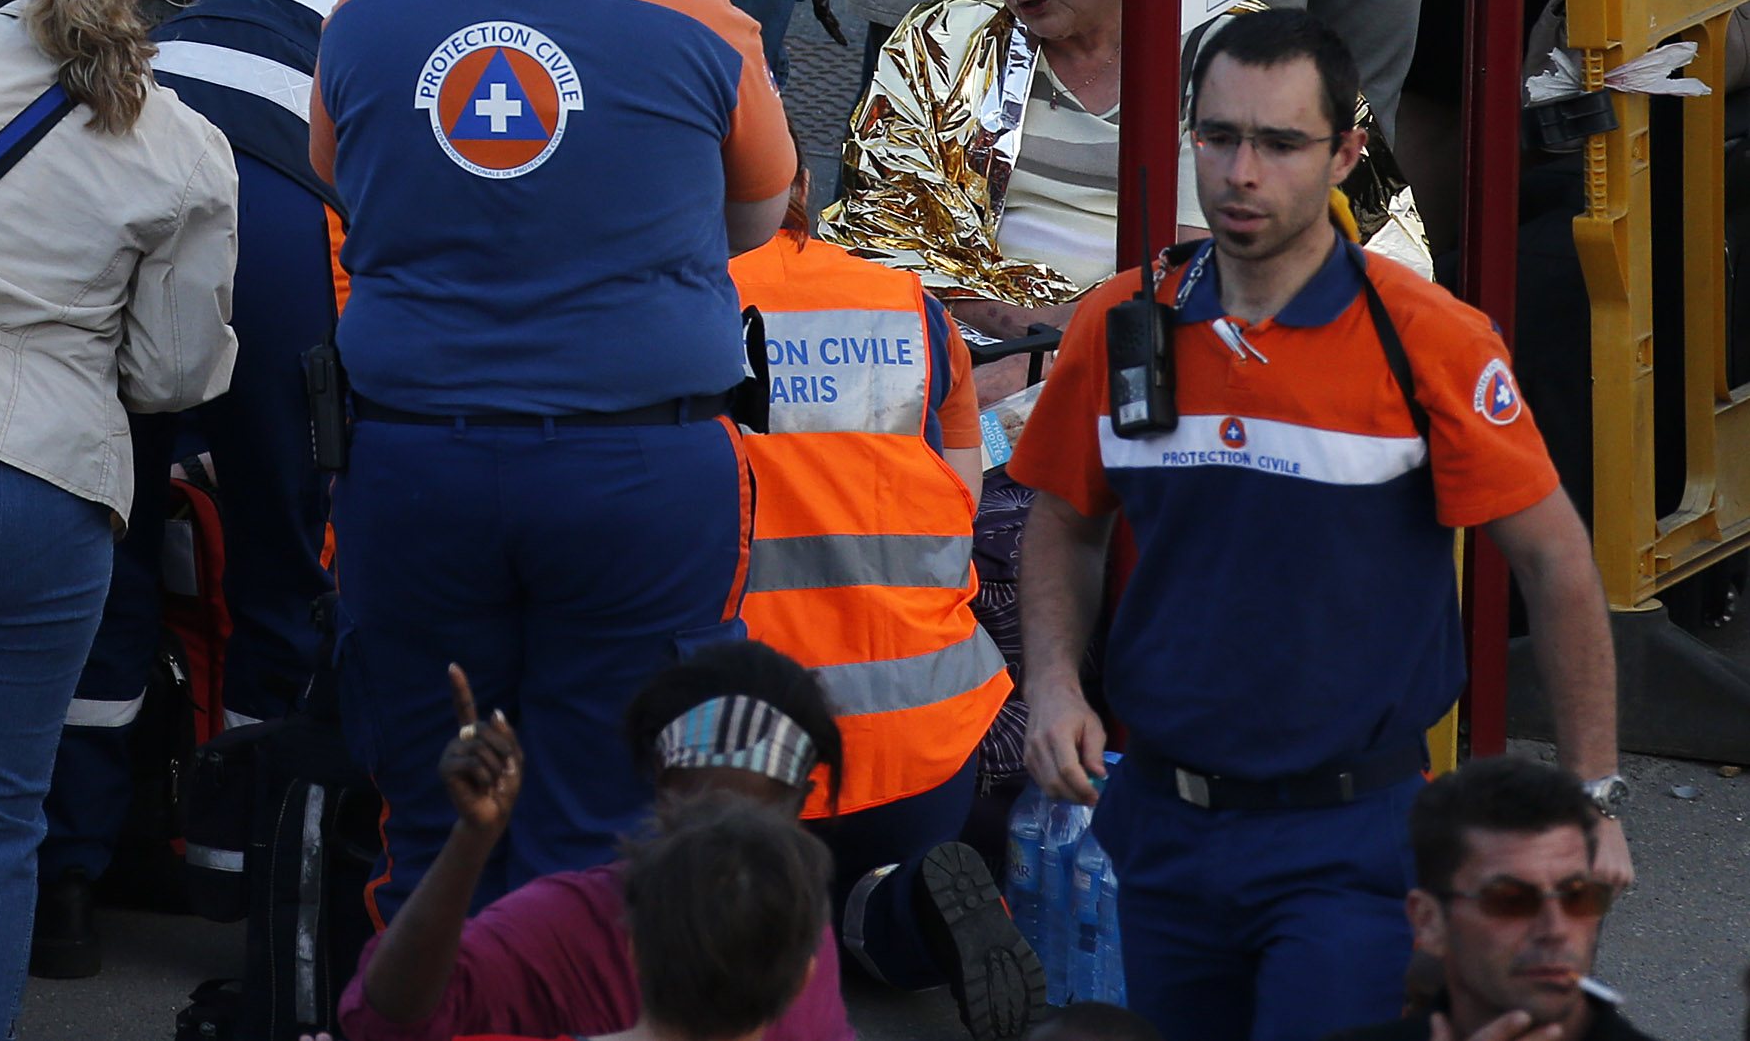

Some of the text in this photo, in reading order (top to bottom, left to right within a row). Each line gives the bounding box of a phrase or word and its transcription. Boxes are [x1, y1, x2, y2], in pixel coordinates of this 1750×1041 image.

[420, 26, 579, 102] PROTECTION CIVILE
[819, 337, 913, 365] CIVILE
[1162, 451, 1301, 474] PROTECTION CIVILE
